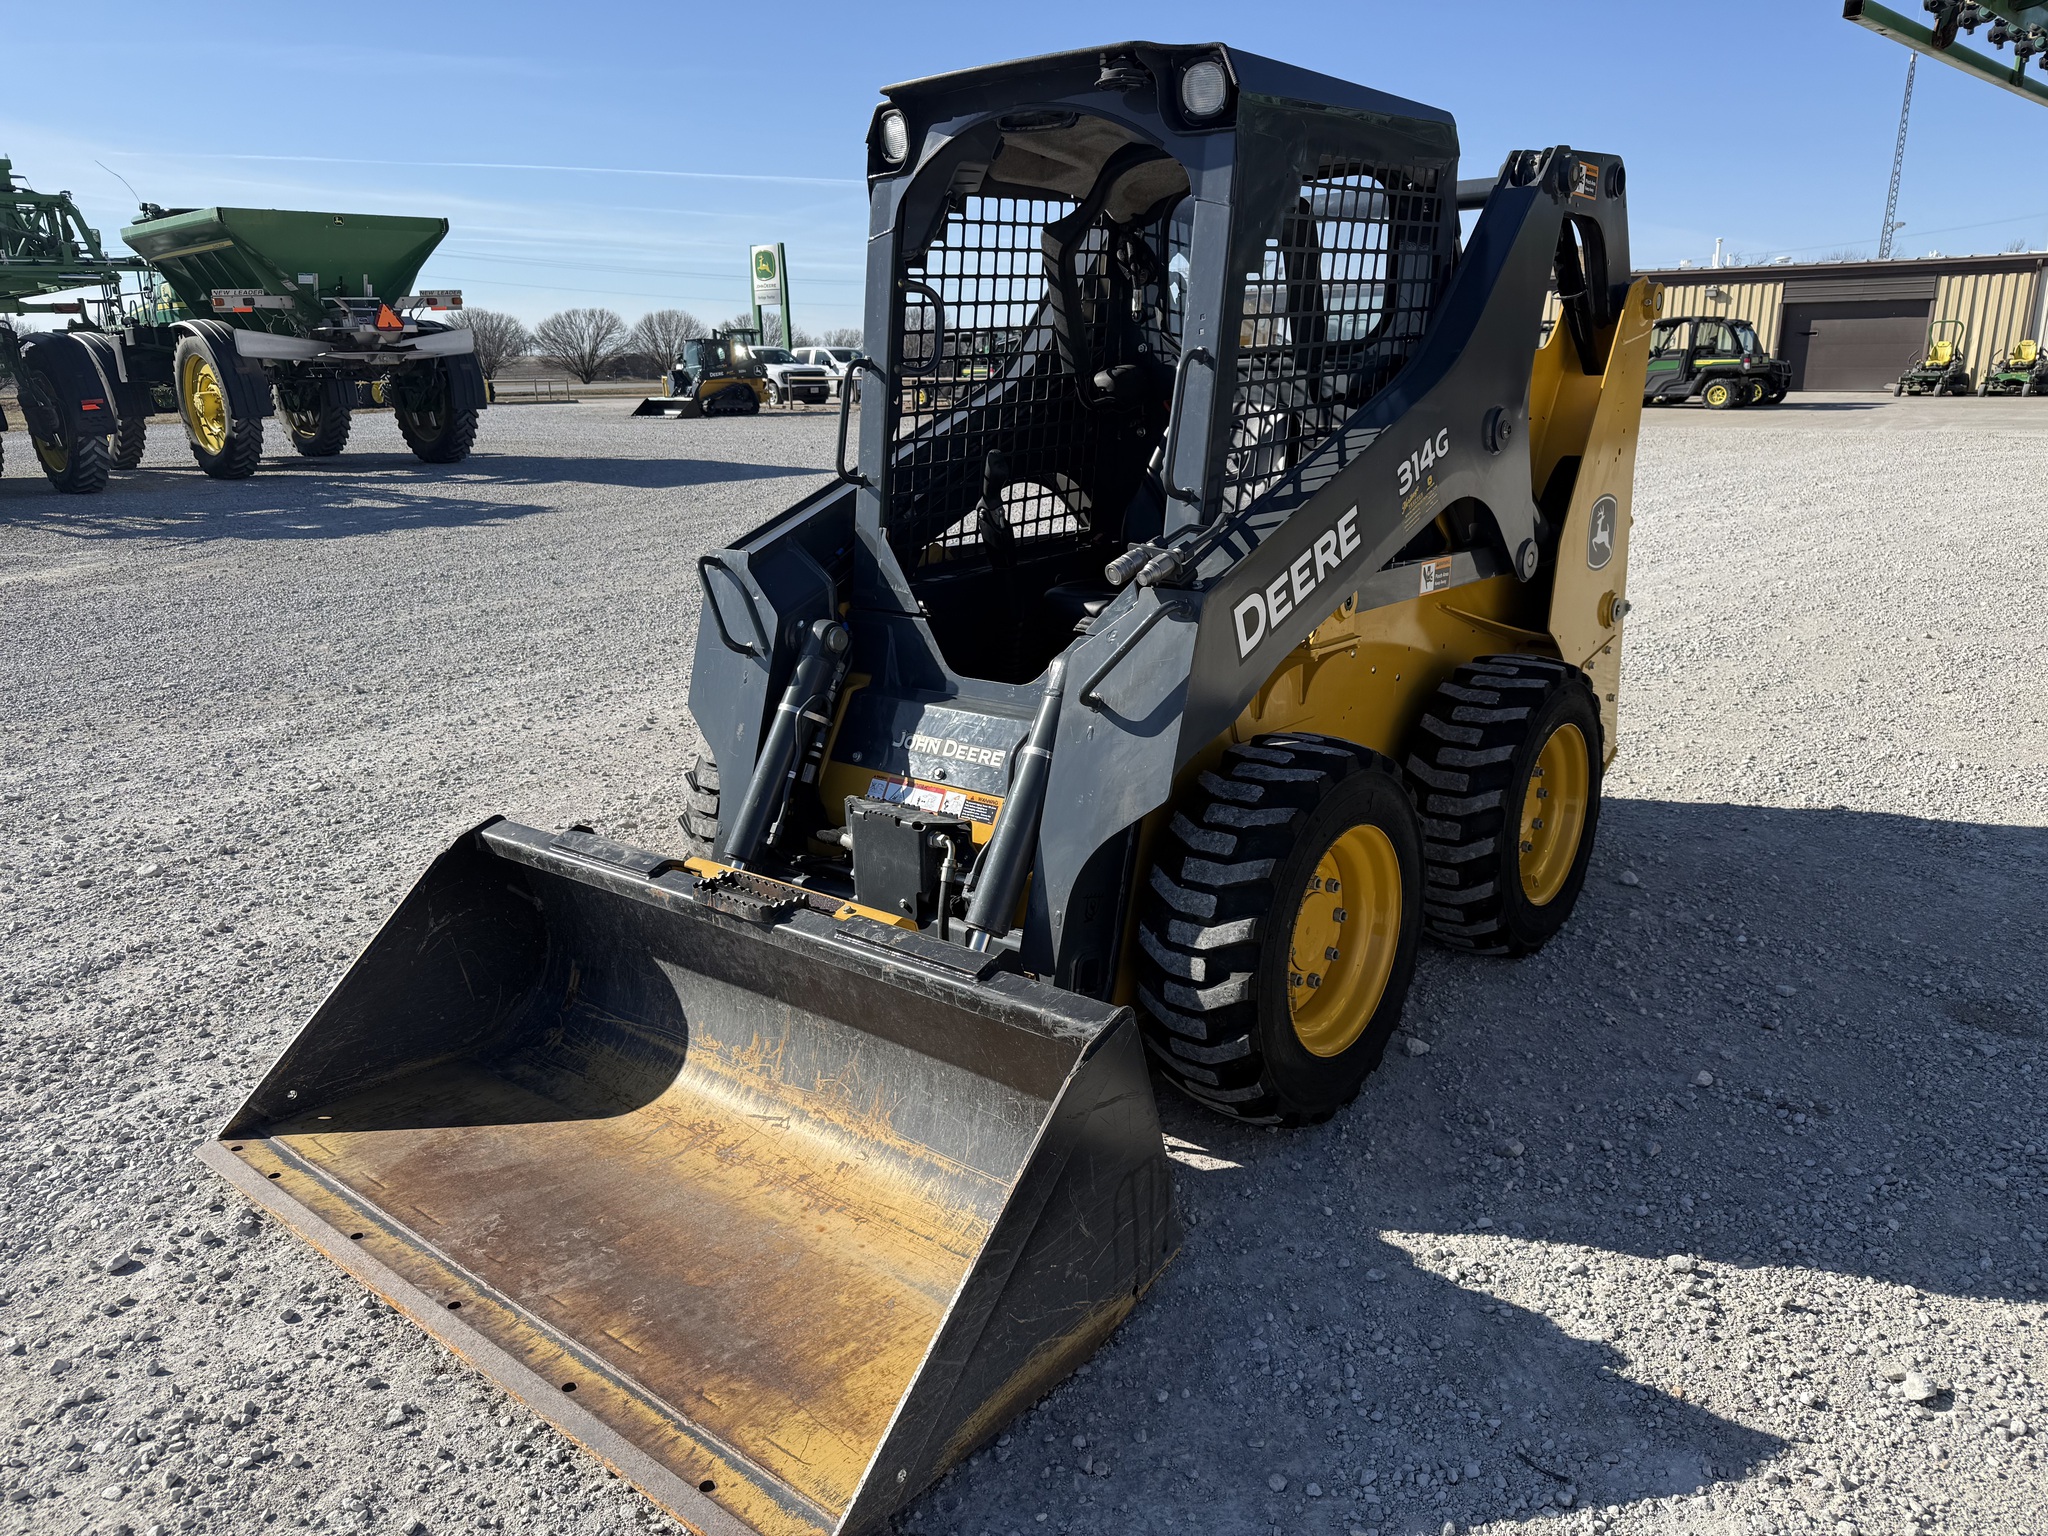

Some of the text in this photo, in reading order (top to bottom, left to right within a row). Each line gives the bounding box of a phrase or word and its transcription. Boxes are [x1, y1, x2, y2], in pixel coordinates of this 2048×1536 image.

[1397, 427, 1449, 496] 314G
[1233, 504, 1361, 659] DEERE
[892, 731, 1006, 768] JOHN DEERE
